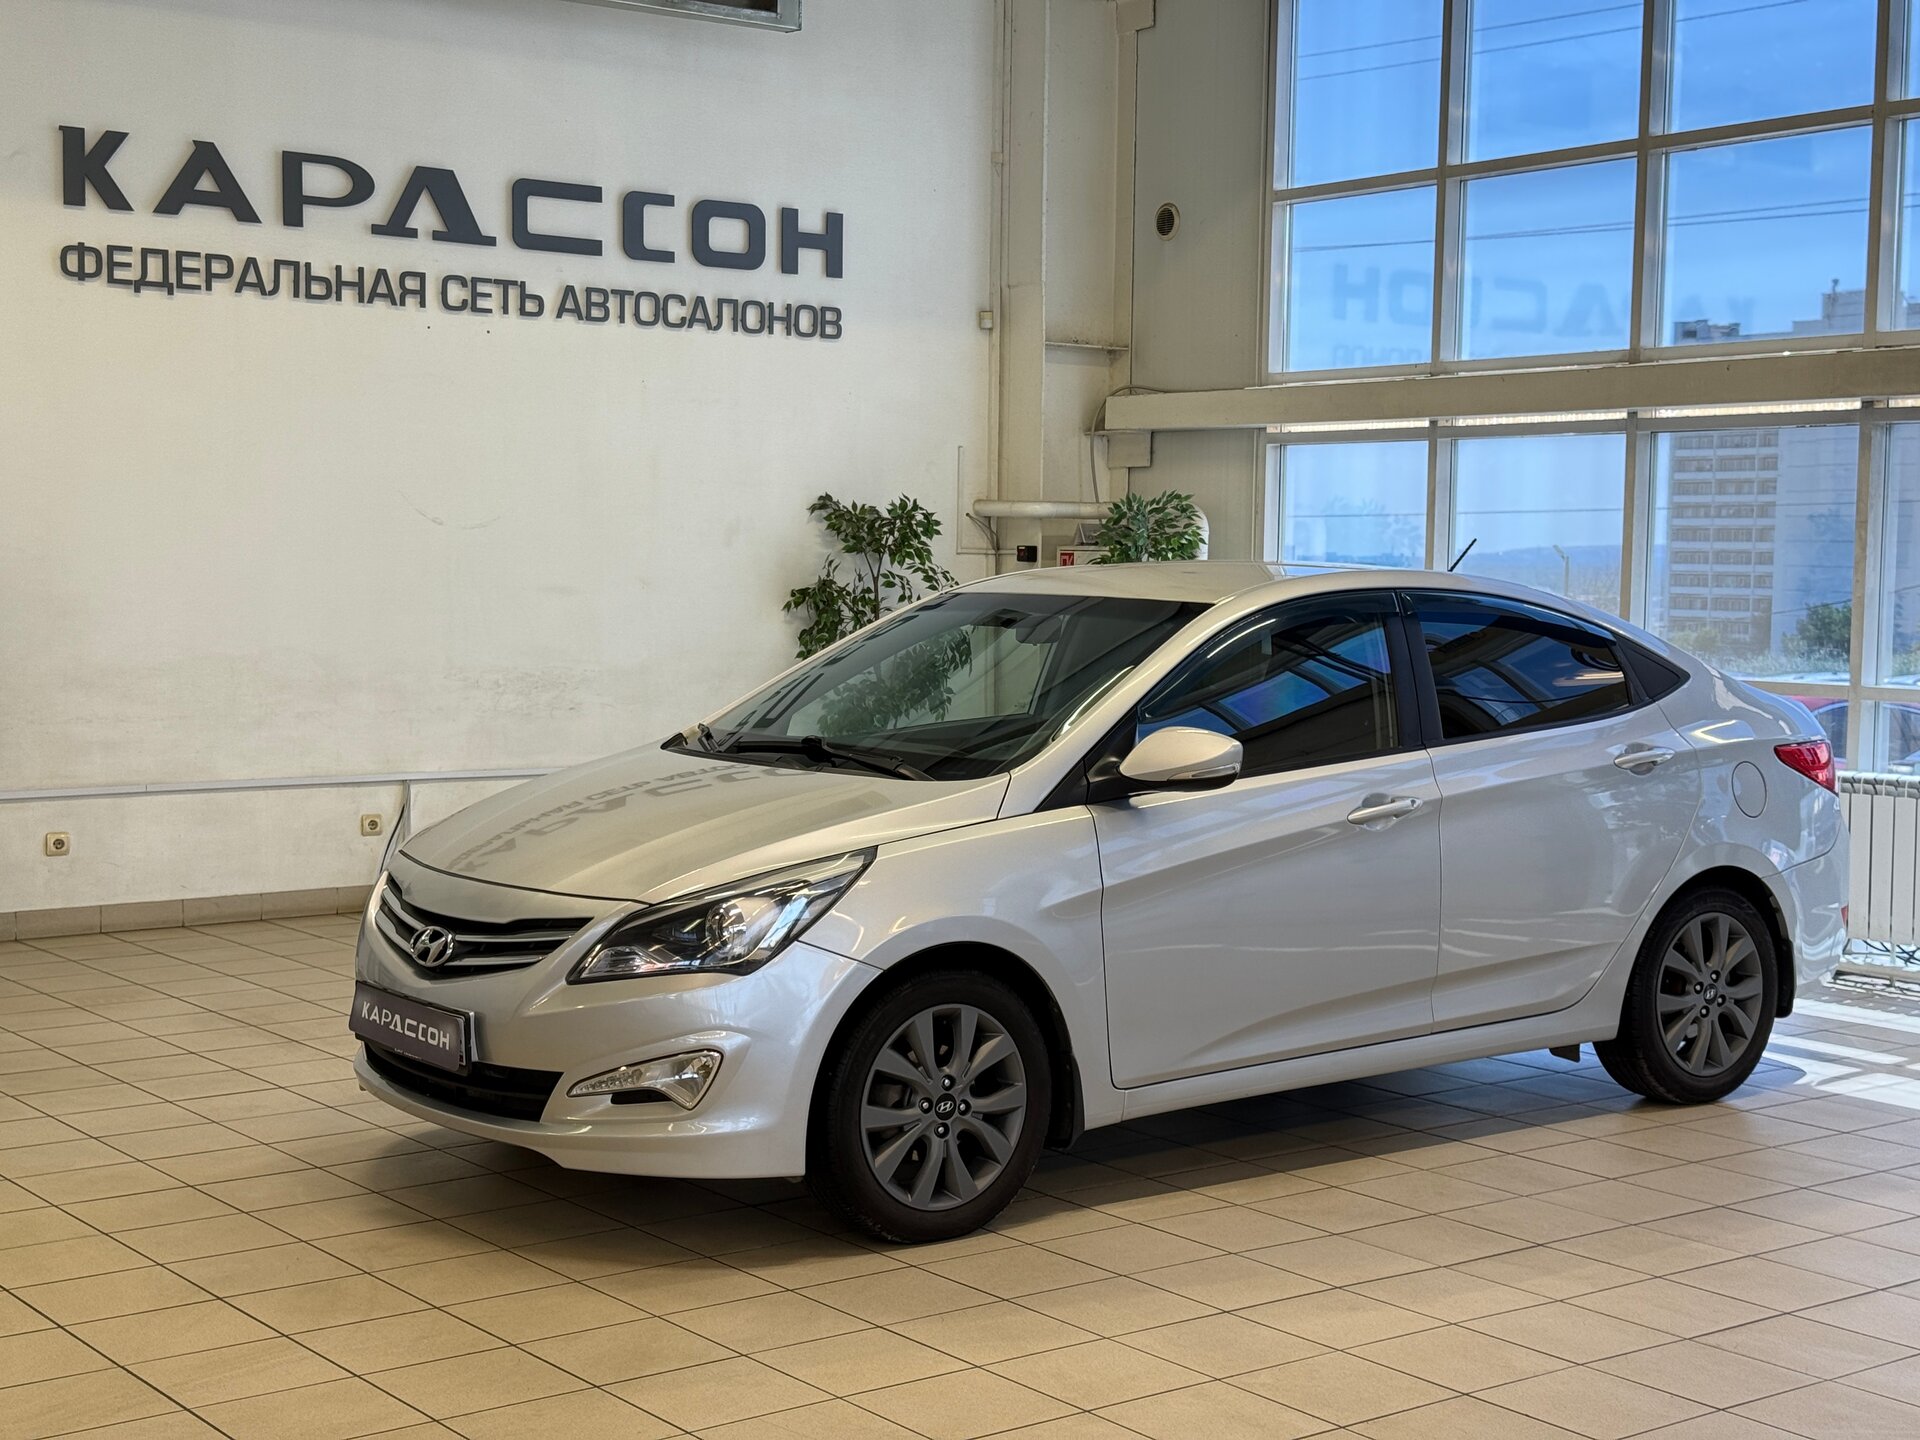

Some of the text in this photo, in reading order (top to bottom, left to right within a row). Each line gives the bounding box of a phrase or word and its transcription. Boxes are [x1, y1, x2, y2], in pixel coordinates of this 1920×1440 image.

[60, 242, 843, 340] ФЕДЕРАЛЬНАЯ СЕТЬ АВТОСАЛОНОВ
